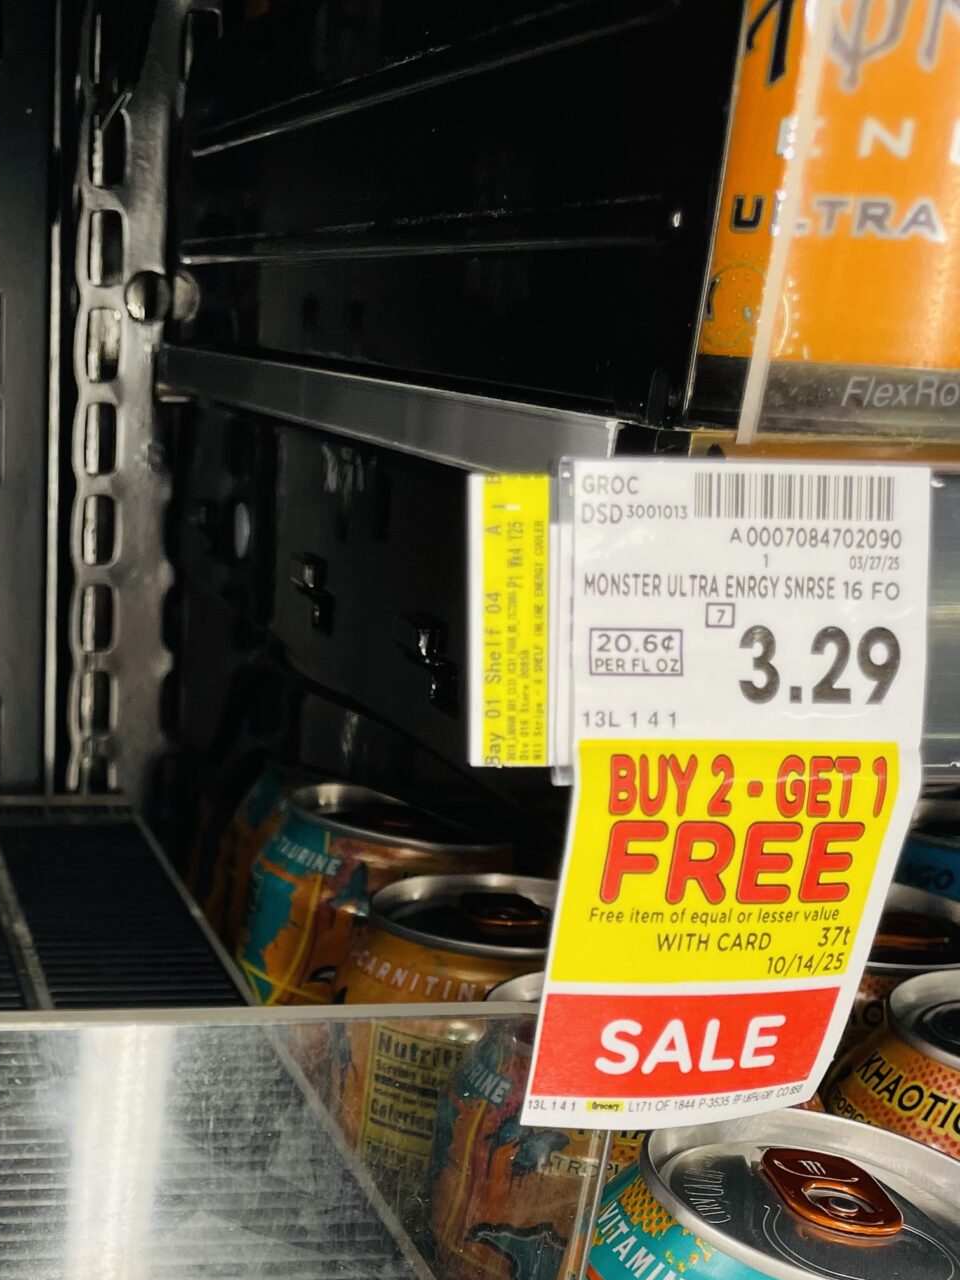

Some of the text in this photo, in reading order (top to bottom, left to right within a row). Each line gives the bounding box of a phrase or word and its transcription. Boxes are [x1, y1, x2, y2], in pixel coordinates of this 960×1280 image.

[582, 476, 639, 495] GROC
[582, 504, 687, 524] DSD 3001013
[746, 529, 902, 549] 0007084702090
[849, 556, 900, 571] 03/27/25
[584, 573, 900, 600] MONSTER ULTRA ENRGY SNRSE 16 FO
[597, 634, 676, 653] 20.6¢
[595, 659, 680, 673] PER FL OZ
[739, 626, 901, 704] 3.29
[485, 591, 504, 766] Bay 01 Shelf 04
[608, 754, 887, 817] BUY 2 GET 1
[599, 820, 866, 904] FREE
[589, 906, 840, 925] Free item of equal or lesser value
[656, 926, 851, 952] WITH CARD 37t
[767, 952, 844, 976] 10/14/25
[594, 1014, 786, 1075] SALE
